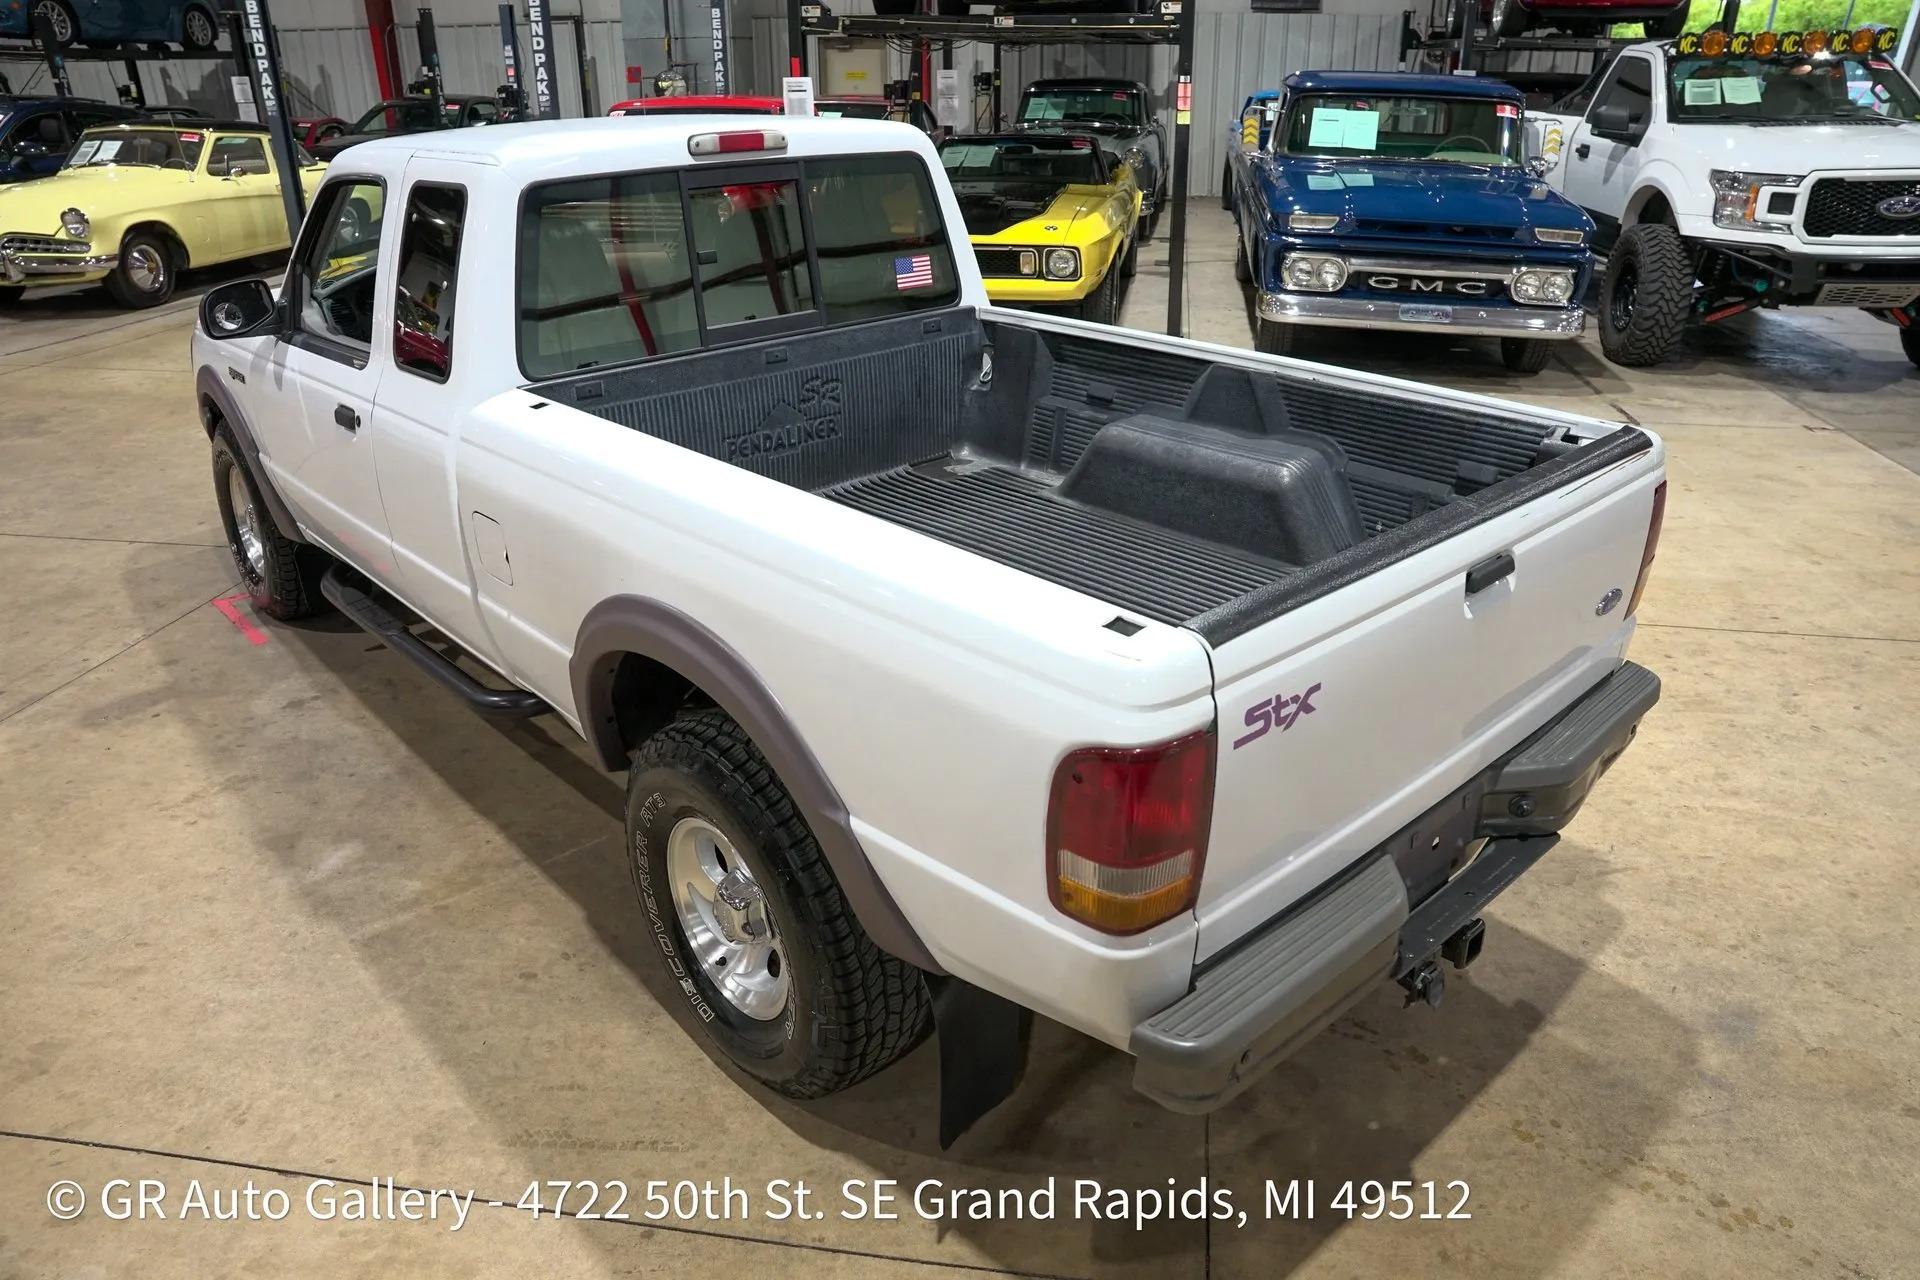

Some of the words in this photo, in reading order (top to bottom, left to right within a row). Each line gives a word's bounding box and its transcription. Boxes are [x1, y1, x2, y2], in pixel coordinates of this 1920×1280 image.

[711, 8, 725, 82] BENDPAK
[1680, 36, 1697, 53] KC
[1731, 36, 1748, 53] KC
[1782, 36, 1799, 53] KC
[1832, 33, 1849, 52] KC
[1878, 30, 1895, 49] KC
[245, 0, 275, 99] BENDPAK
[1368, 276, 1486, 294] GMC
[725, 416, 842, 461] PENDALINER
[640, 792, 667, 828] AT3
[636, 831, 715, 1022] DISCOVERER
